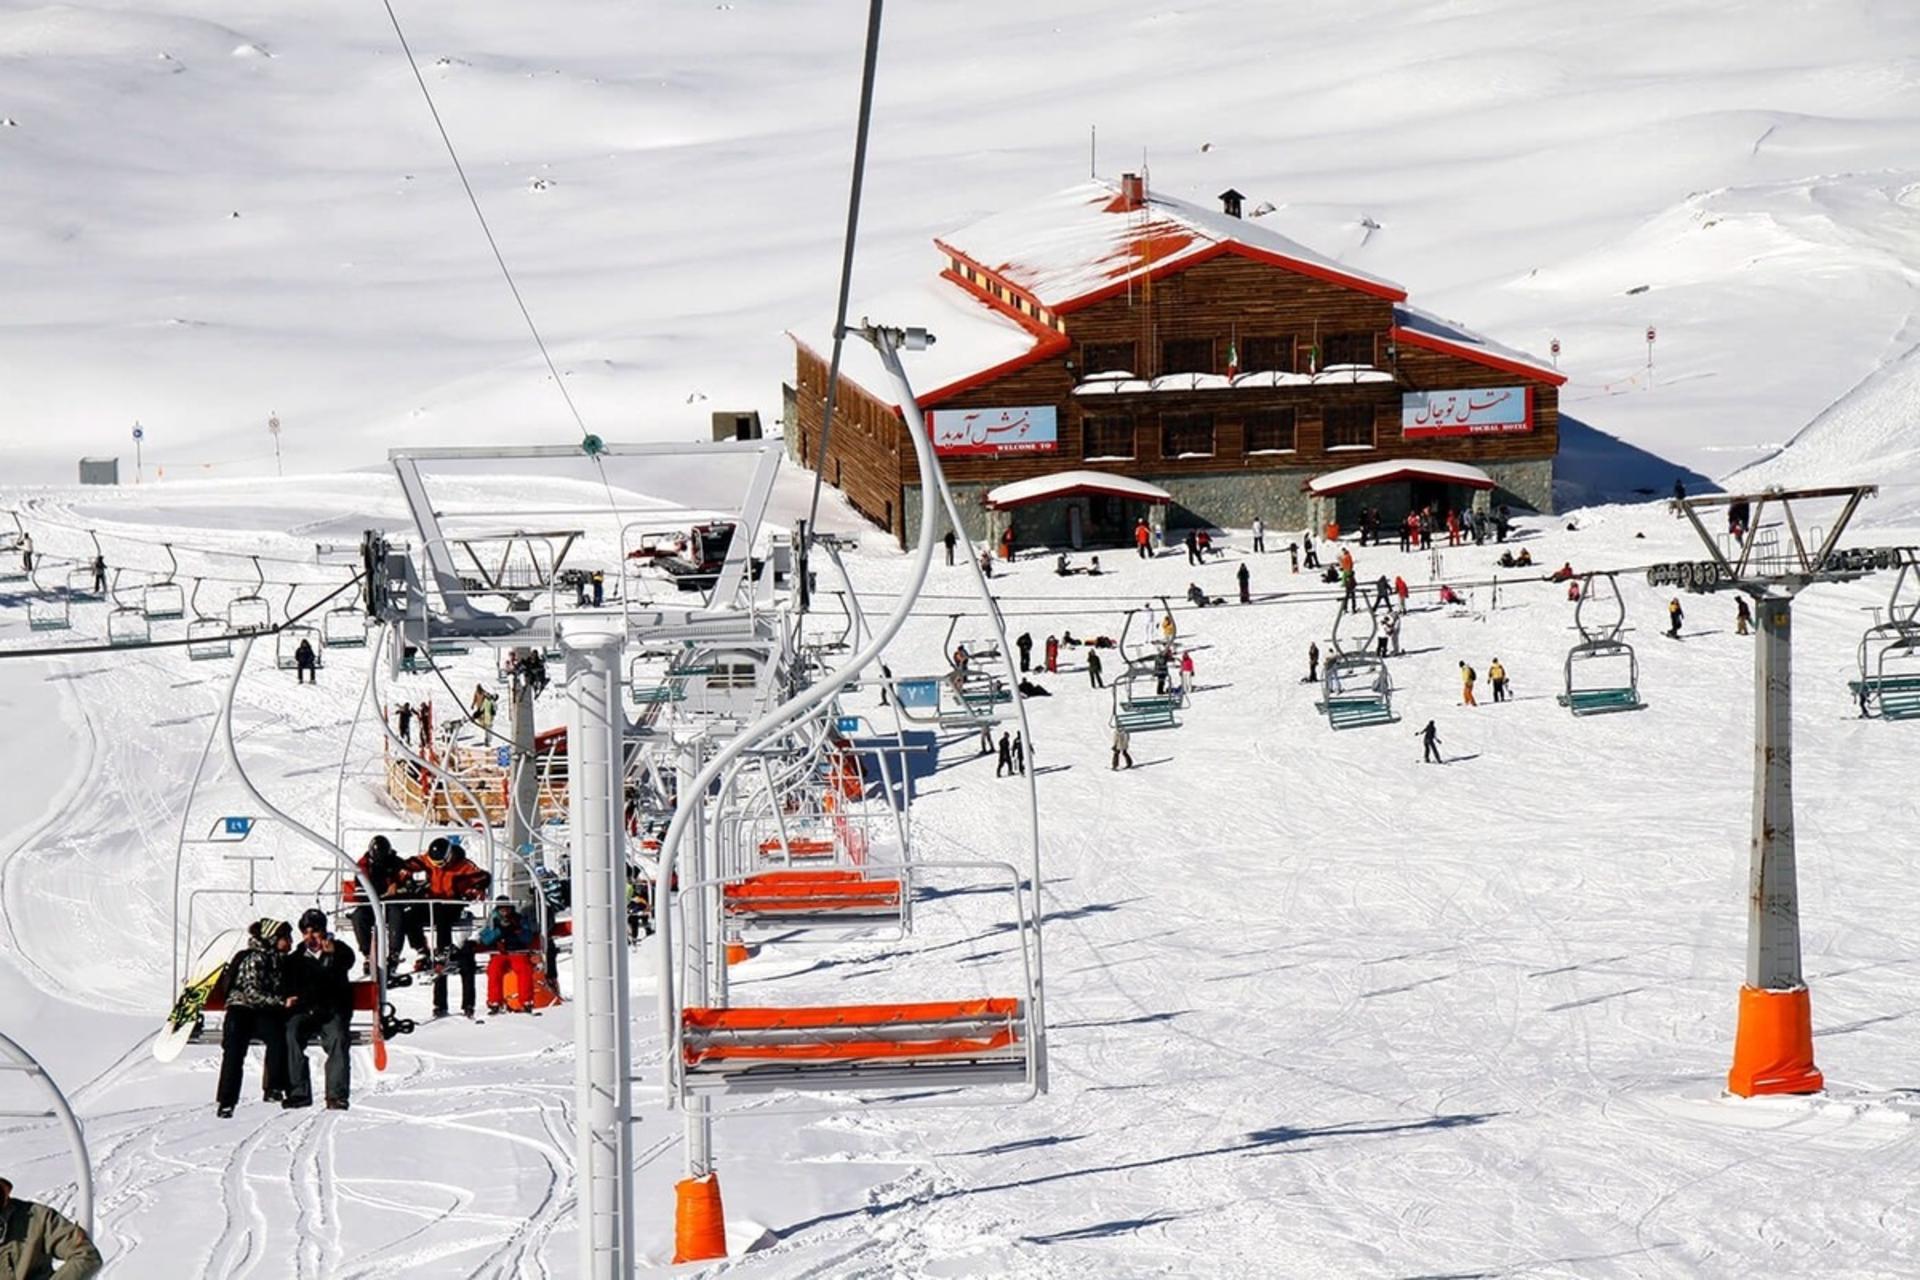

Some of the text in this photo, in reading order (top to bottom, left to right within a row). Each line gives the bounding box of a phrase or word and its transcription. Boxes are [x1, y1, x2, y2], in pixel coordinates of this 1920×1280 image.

[1415, 391, 1510, 429] هتل توچال
[1502, 423, 1528, 431] HOTEL
[941, 411, 1030, 448] خوش آمدید
